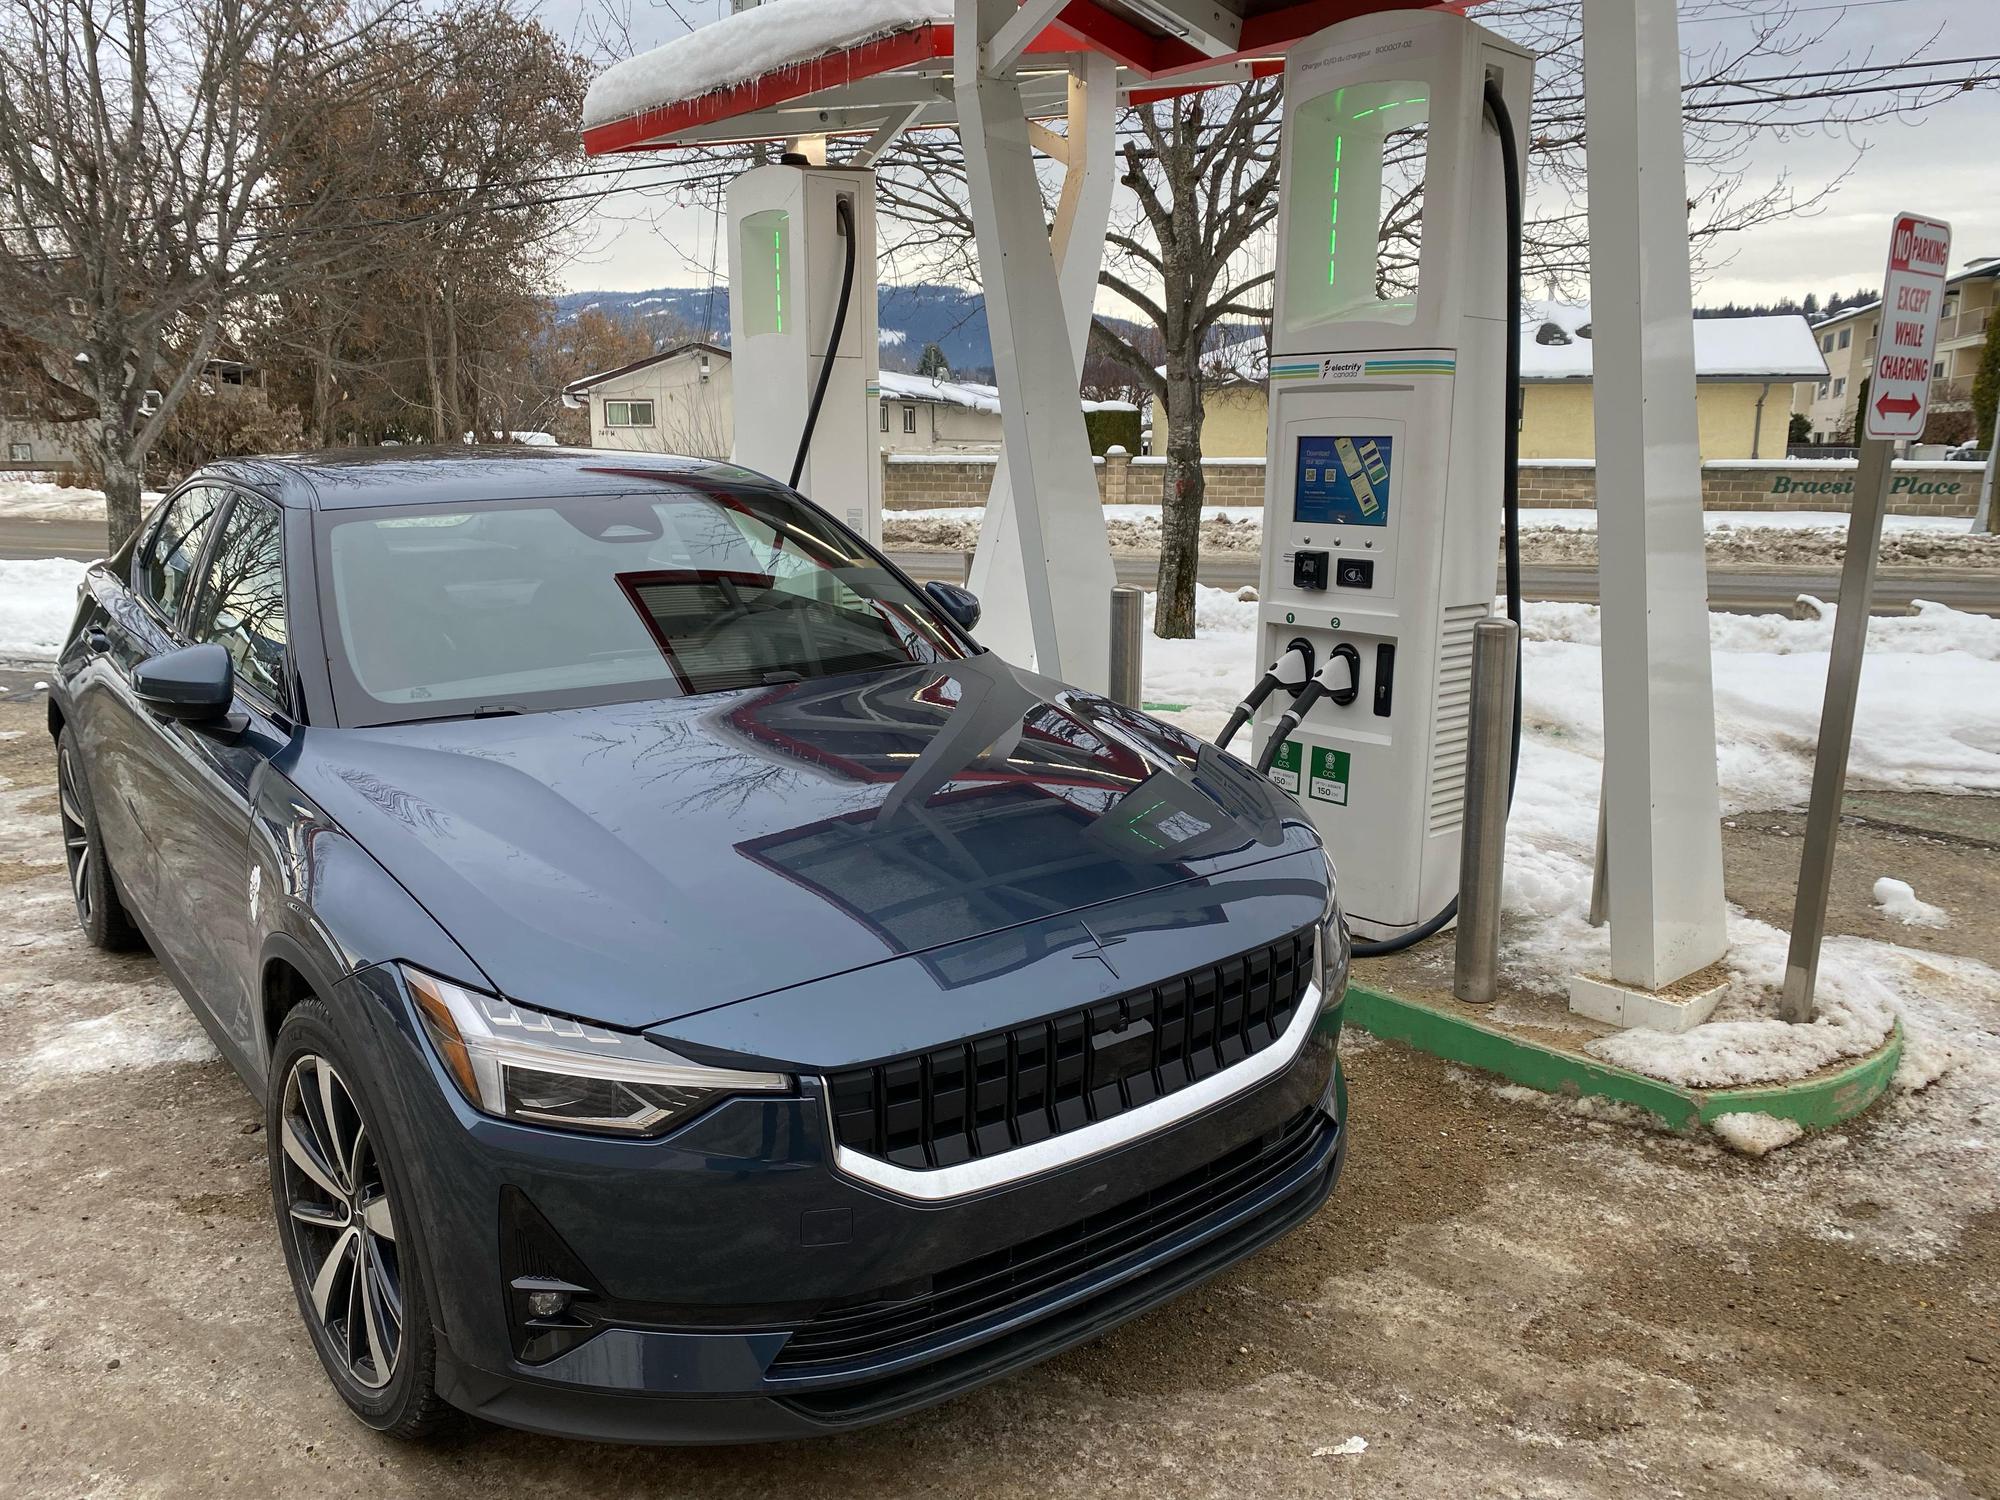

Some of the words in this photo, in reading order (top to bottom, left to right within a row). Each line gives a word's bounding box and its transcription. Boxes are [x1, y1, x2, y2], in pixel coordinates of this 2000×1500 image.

[1894, 229, 1911, 261] NO
[1911, 236, 1947, 266] PARKING
[1897, 286, 1931, 314] EXCEPT
[1895, 321, 1925, 348] WHILE
[1331, 363, 1362, 372] electrify
[1880, 355, 1928, 382] CHARGING
[1771, 475, 1856, 495] Braesi
[1889, 475, 1962, 495] Place
[1277, 760, 1290, 768] CCS
[1273, 776, 1286, 785] 150
[1322, 770, 1336, 779] CCS
[1317, 787, 1331, 796] 150
